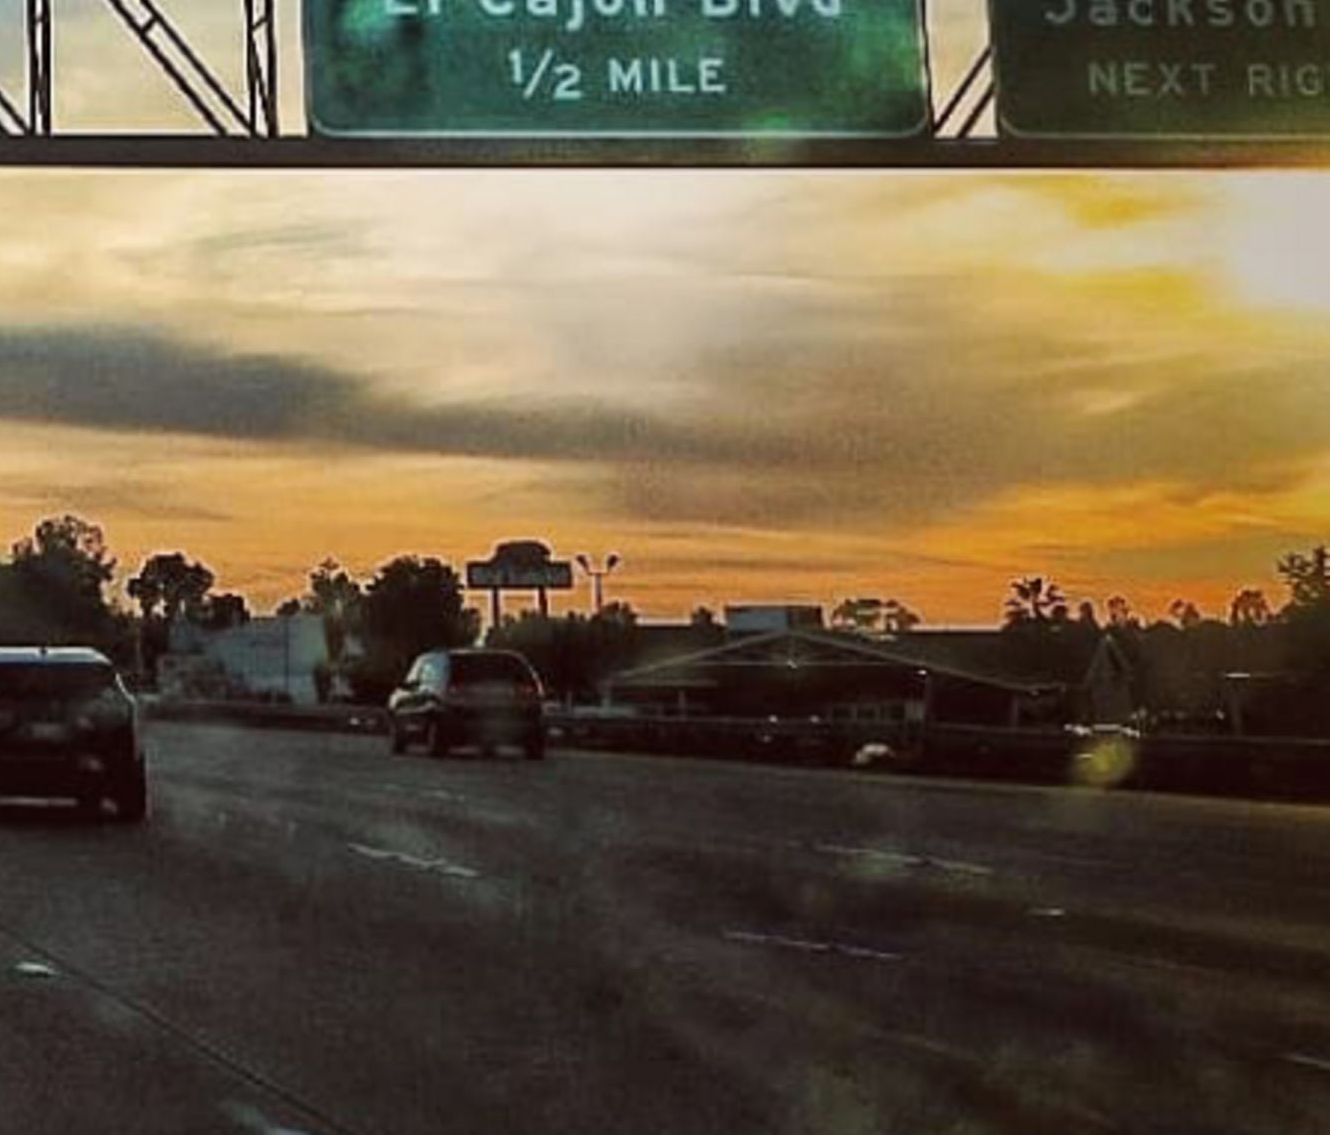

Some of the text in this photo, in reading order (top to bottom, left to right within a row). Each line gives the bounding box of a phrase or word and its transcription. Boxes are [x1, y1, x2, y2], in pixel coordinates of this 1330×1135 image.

[609, 59, 726, 92] MILE
[1088, 63, 1330, 96] NEXT RIG
